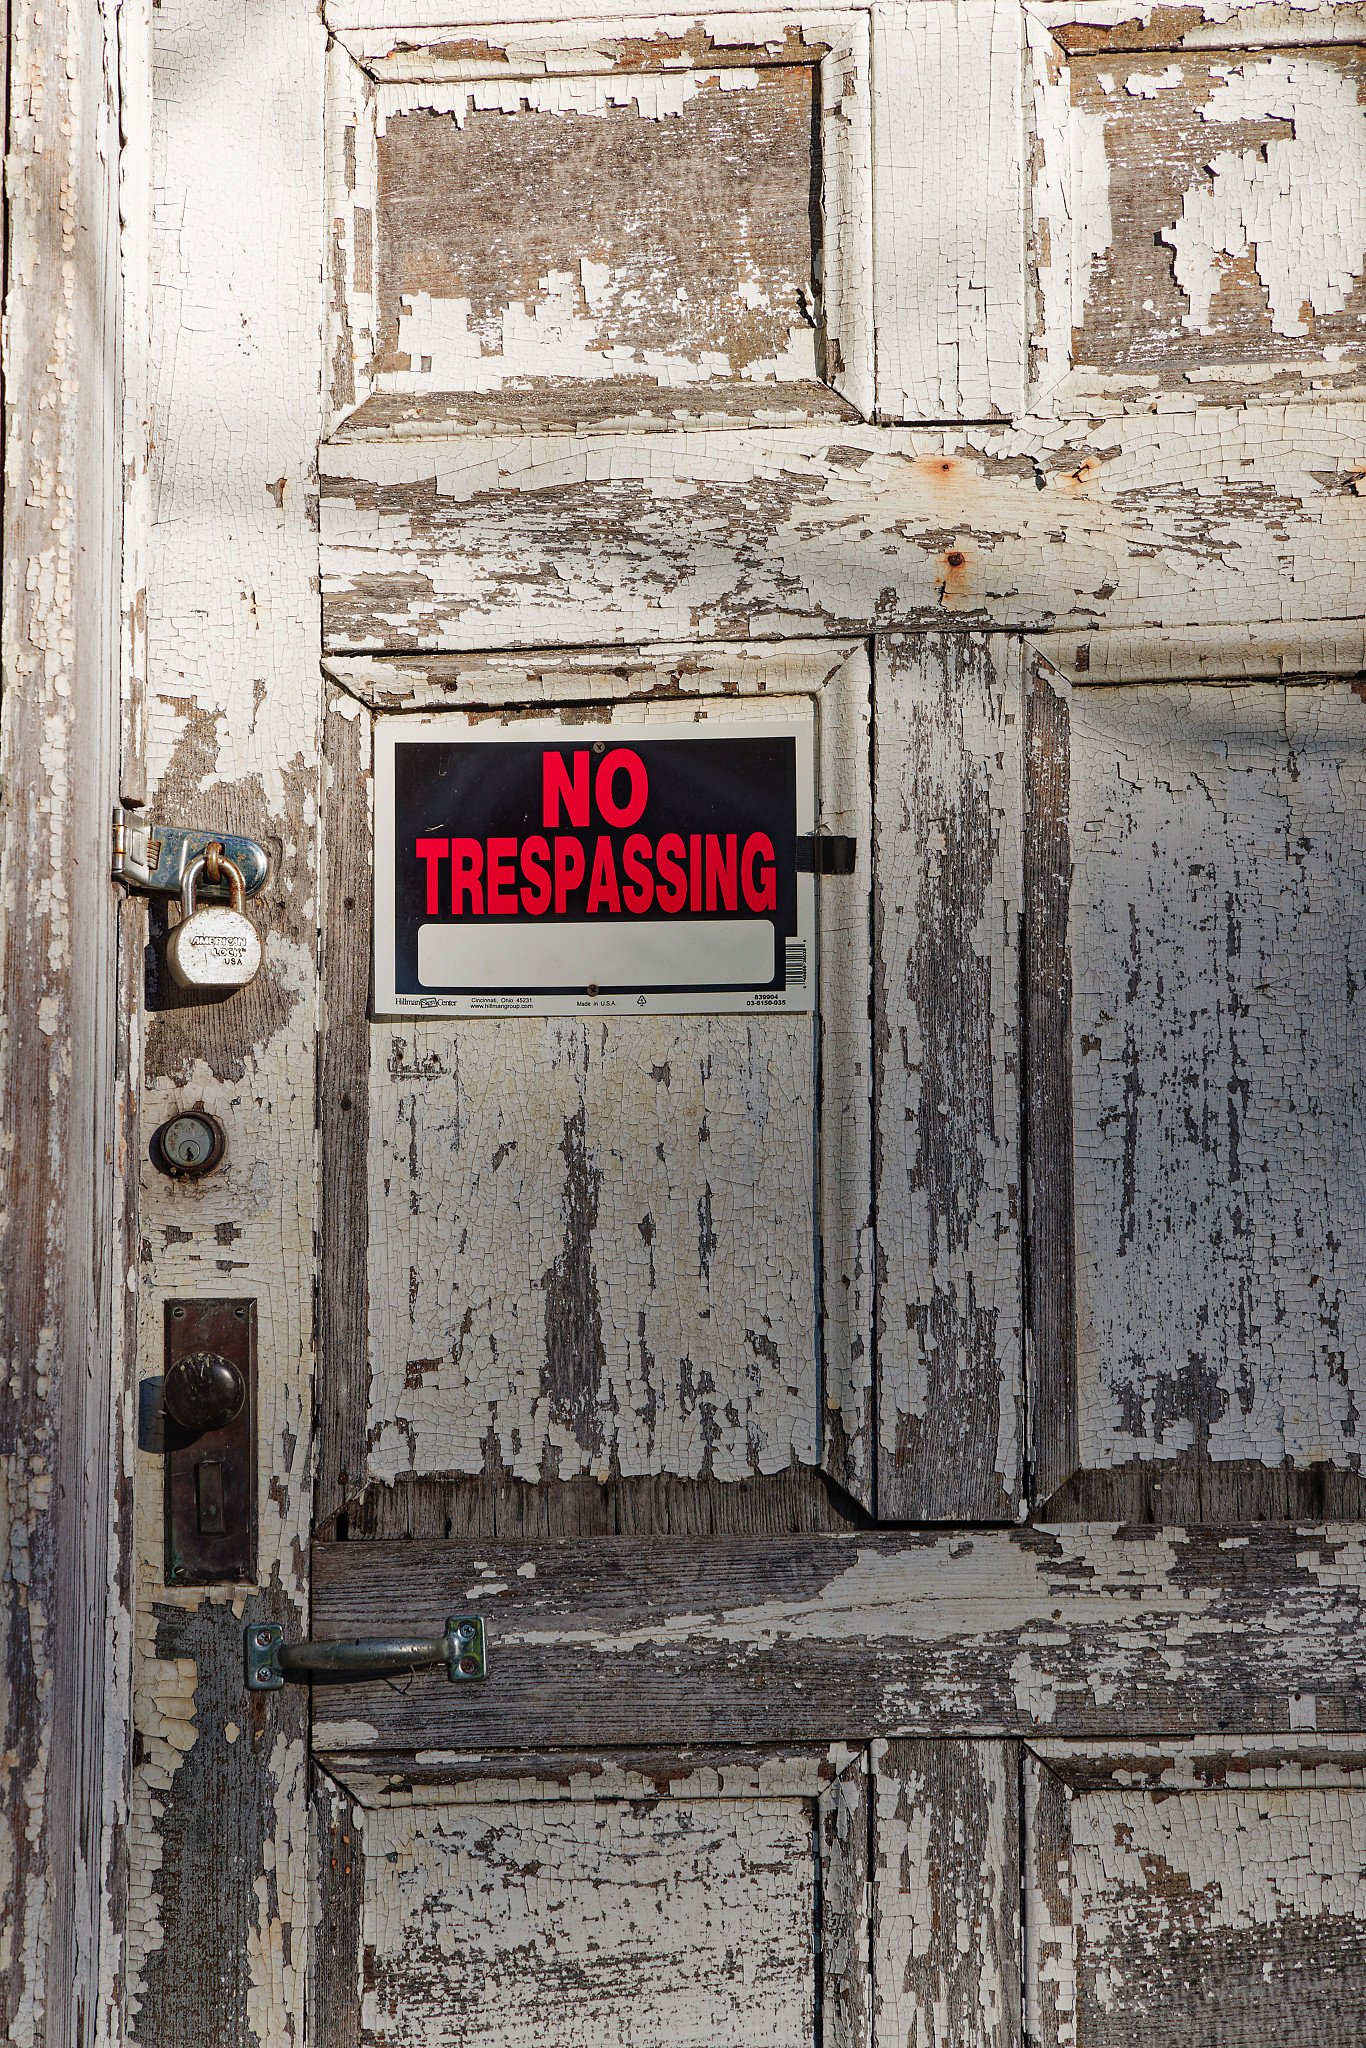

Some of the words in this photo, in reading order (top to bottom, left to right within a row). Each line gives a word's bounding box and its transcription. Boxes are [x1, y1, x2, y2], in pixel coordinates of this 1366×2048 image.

[542, 748, 649, 828] NO
[416, 831, 777, 916] TRESPASSING
[192, 935, 247, 946] AMERICAN
[224, 957, 243, 966] USA
[437, 998, 457, 1007] Center
